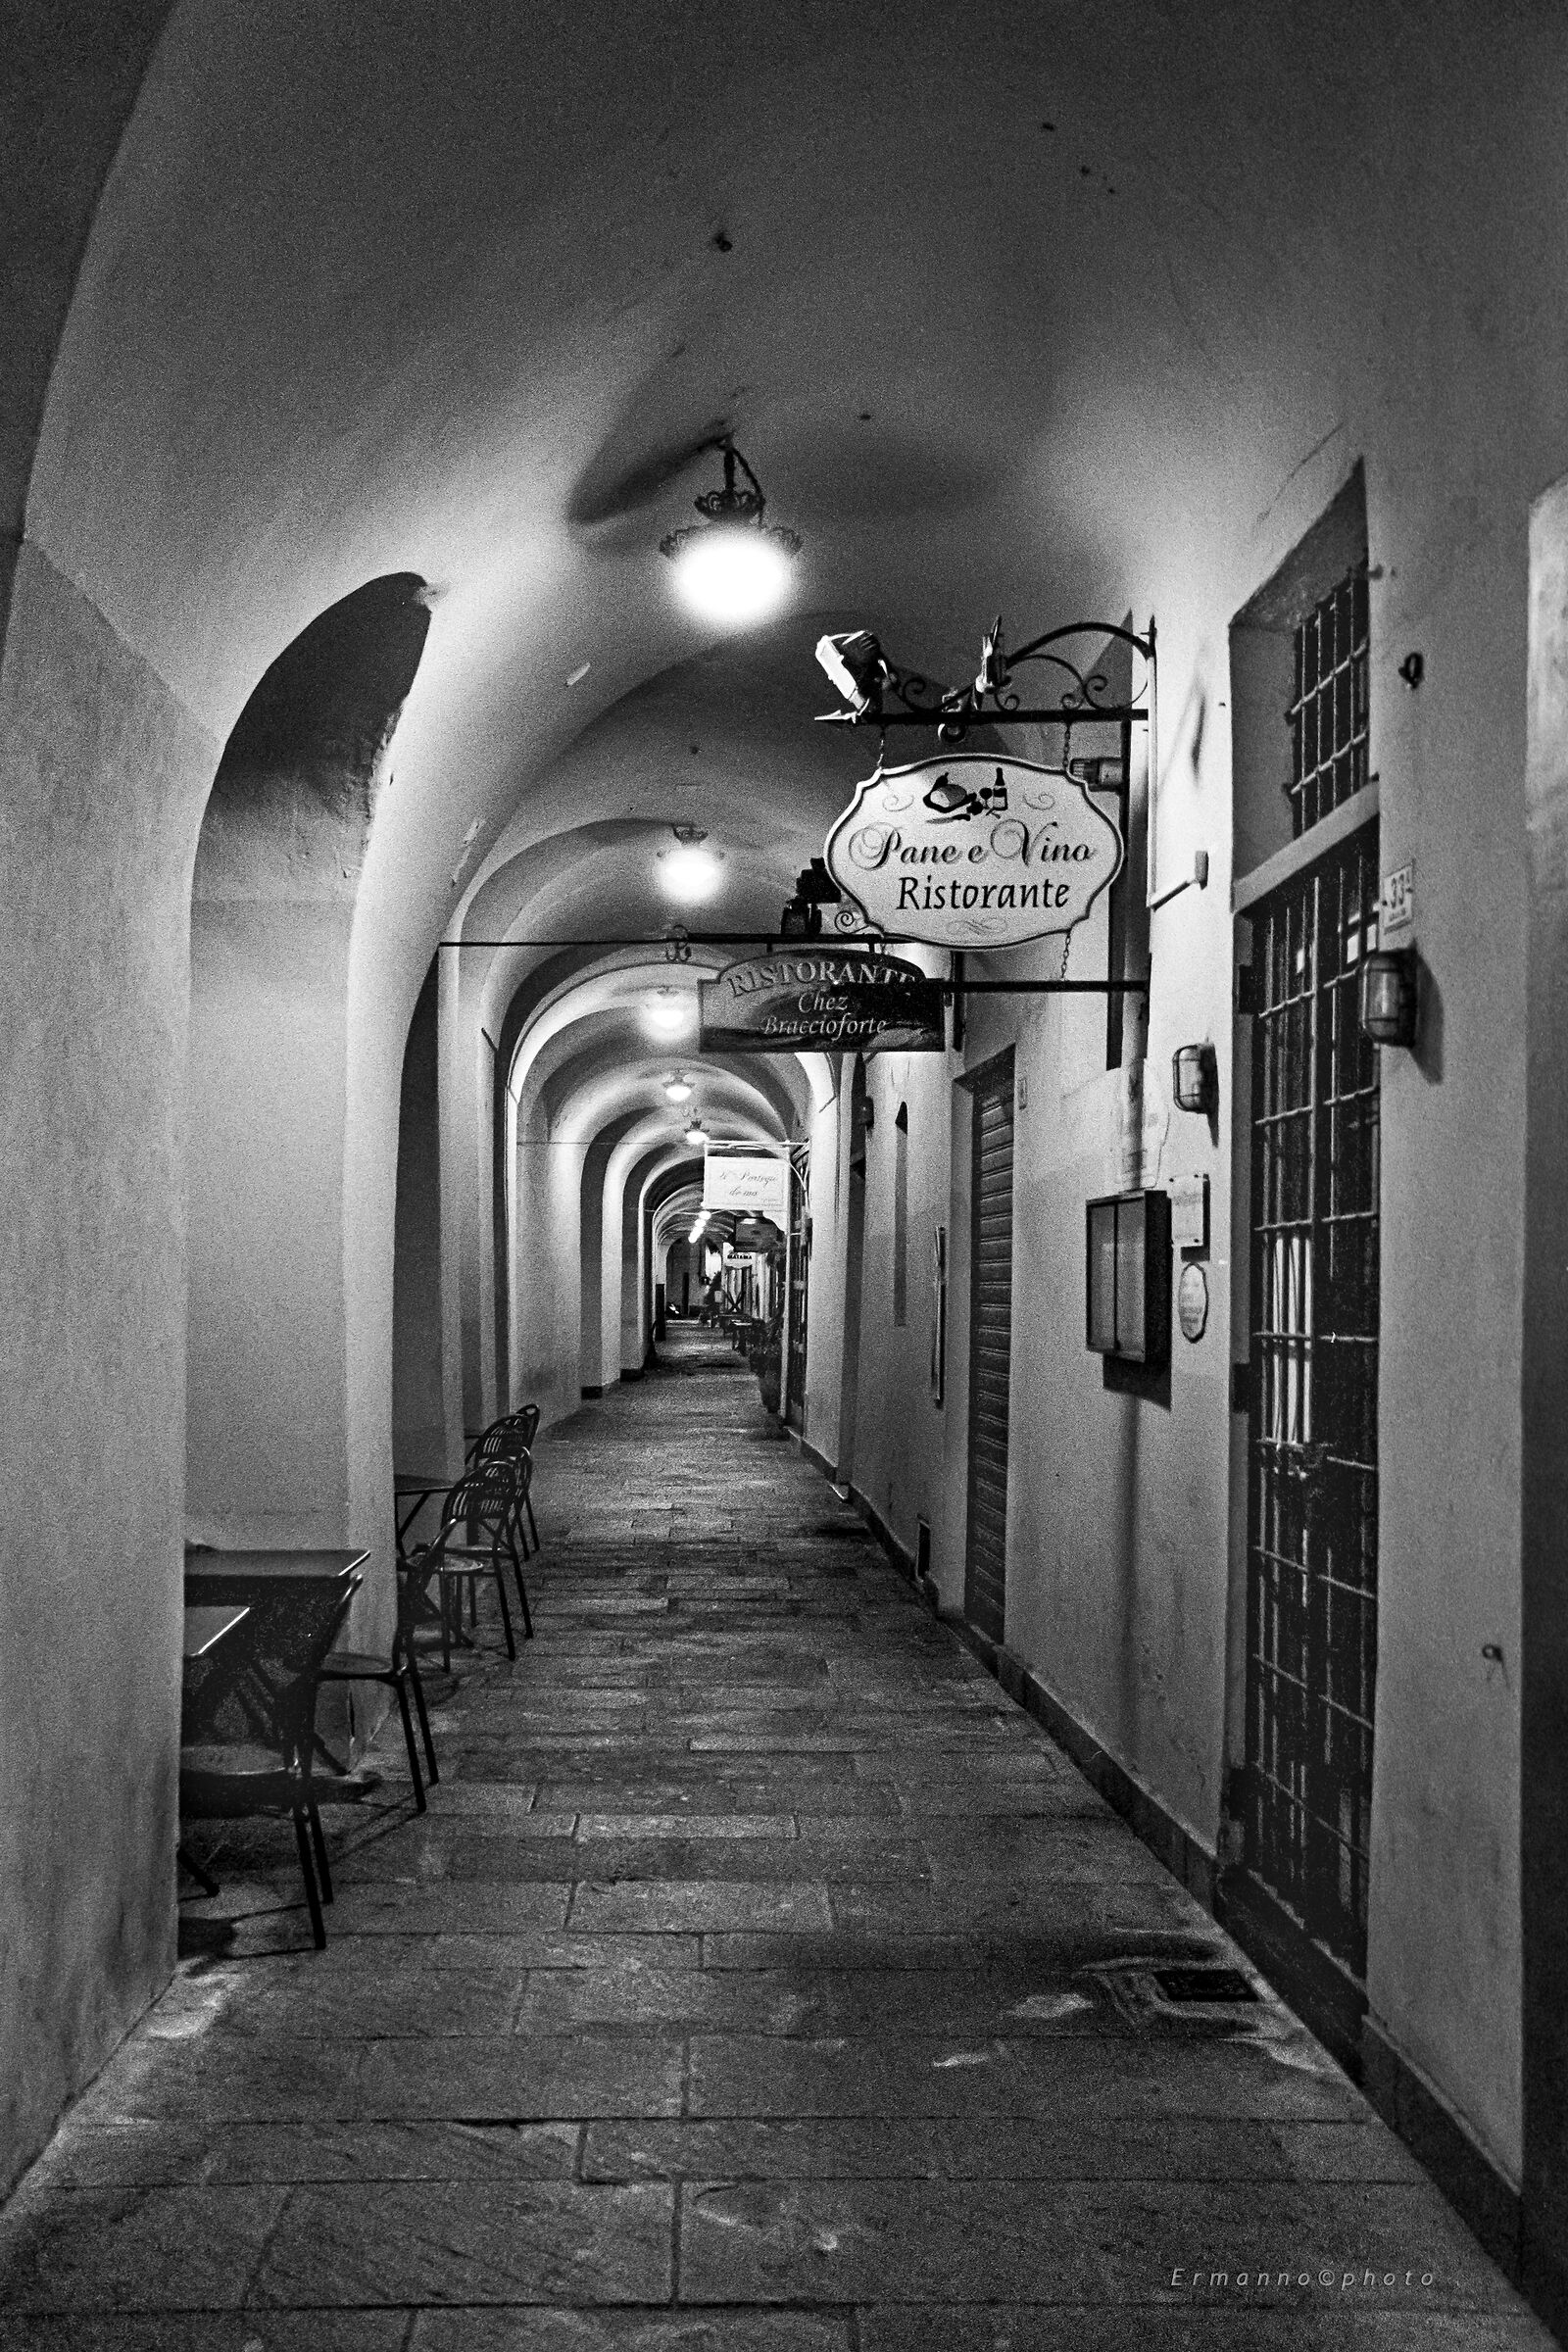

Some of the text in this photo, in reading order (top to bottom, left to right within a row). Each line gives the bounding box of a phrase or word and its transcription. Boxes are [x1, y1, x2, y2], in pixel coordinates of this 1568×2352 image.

[848, 818, 1096, 869] Pane e Vino
[896, 876, 1069, 909] Ristorante
[798, 991, 849, 1013] Chez
[759, 1012, 888, 1041] Braccioforte
